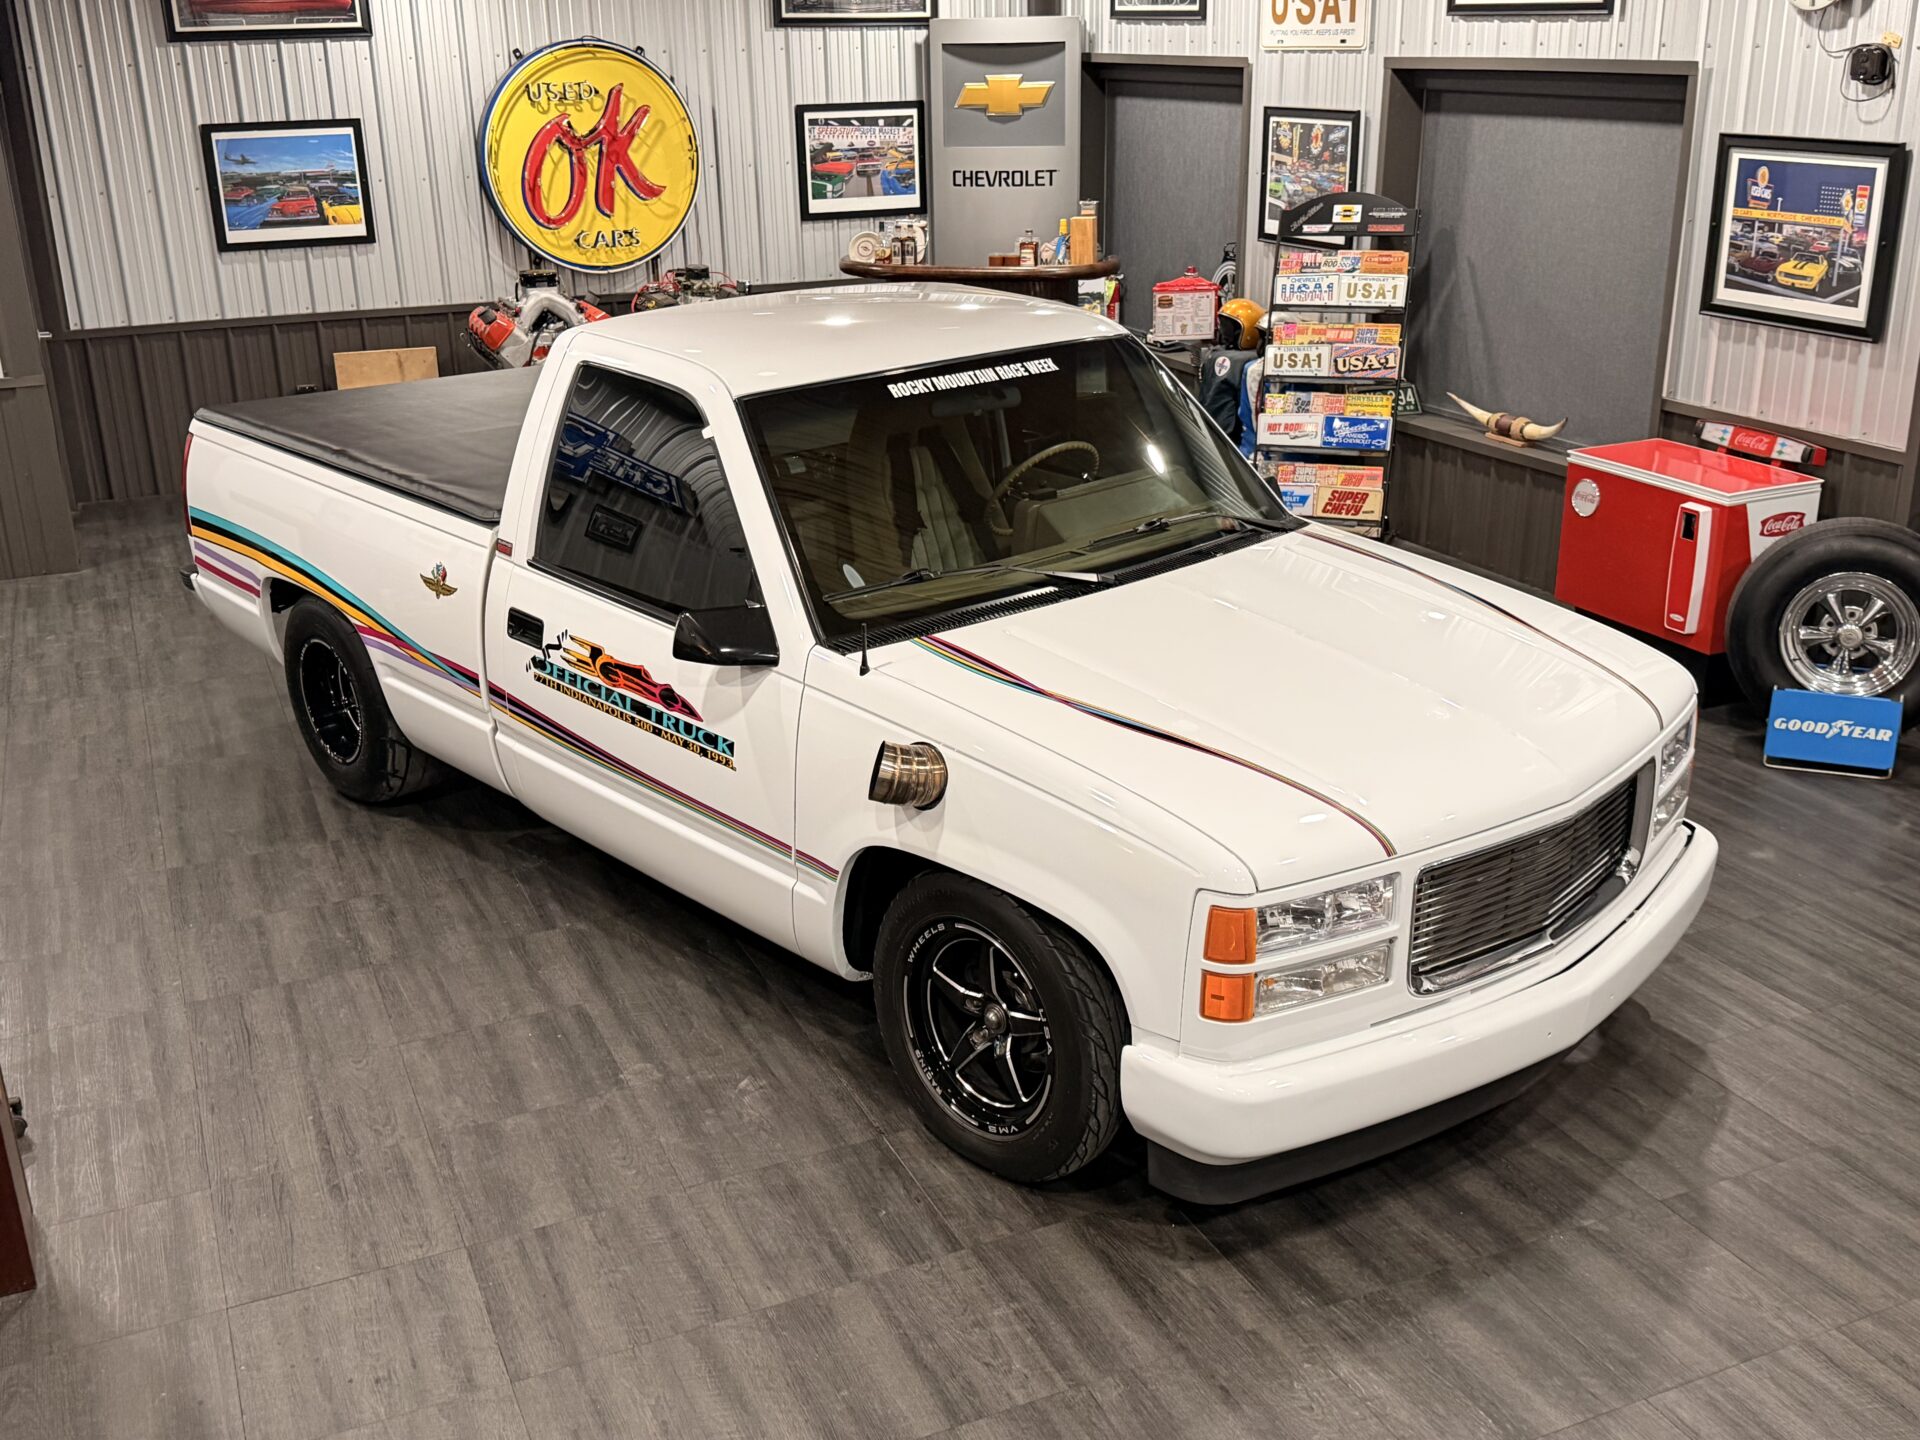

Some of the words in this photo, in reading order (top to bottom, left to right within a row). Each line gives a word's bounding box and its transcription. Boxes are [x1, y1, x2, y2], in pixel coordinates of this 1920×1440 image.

[526, 80, 599, 103] USED
[521, 83, 667, 230] OK
[952, 169, 1058, 188] CHEVROLET
[1800, 215, 1836, 225] CHEVROLET
[575, 227, 641, 249] CARS
[1322, 259, 1338, 268] ROD
[1355, 336, 1378, 344] CHEVY
[1356, 328, 1379, 337] SUPER
[887, 377, 936, 399] ROCKY
[931, 367, 1000, 391] MOUNTAIN
[994, 362, 1028, 381] RACE
[1023, 357, 1060, 376] WEEK
[1267, 423, 1283, 432] HOT
[1328, 490, 1370, 504] SUPER
[1321, 502, 1364, 516] CHEVY
[533, 656, 637, 715] OFFICIAL
[646, 704, 735, 758] TRUCK
[534, 671, 558, 691] 77TH
[559, 681, 632, 724] INDIANAPOLIS
[634, 715, 654, 734] 500
[660, 728, 685, 747] MAY
[686, 740, 704, 758] 30,
[706, 750, 735, 769] 1993
[1773, 717, 1893, 742] GOODYEAR
[907, 922, 946, 964] WHEELS
[988, 1125, 1019, 1135] VMS
